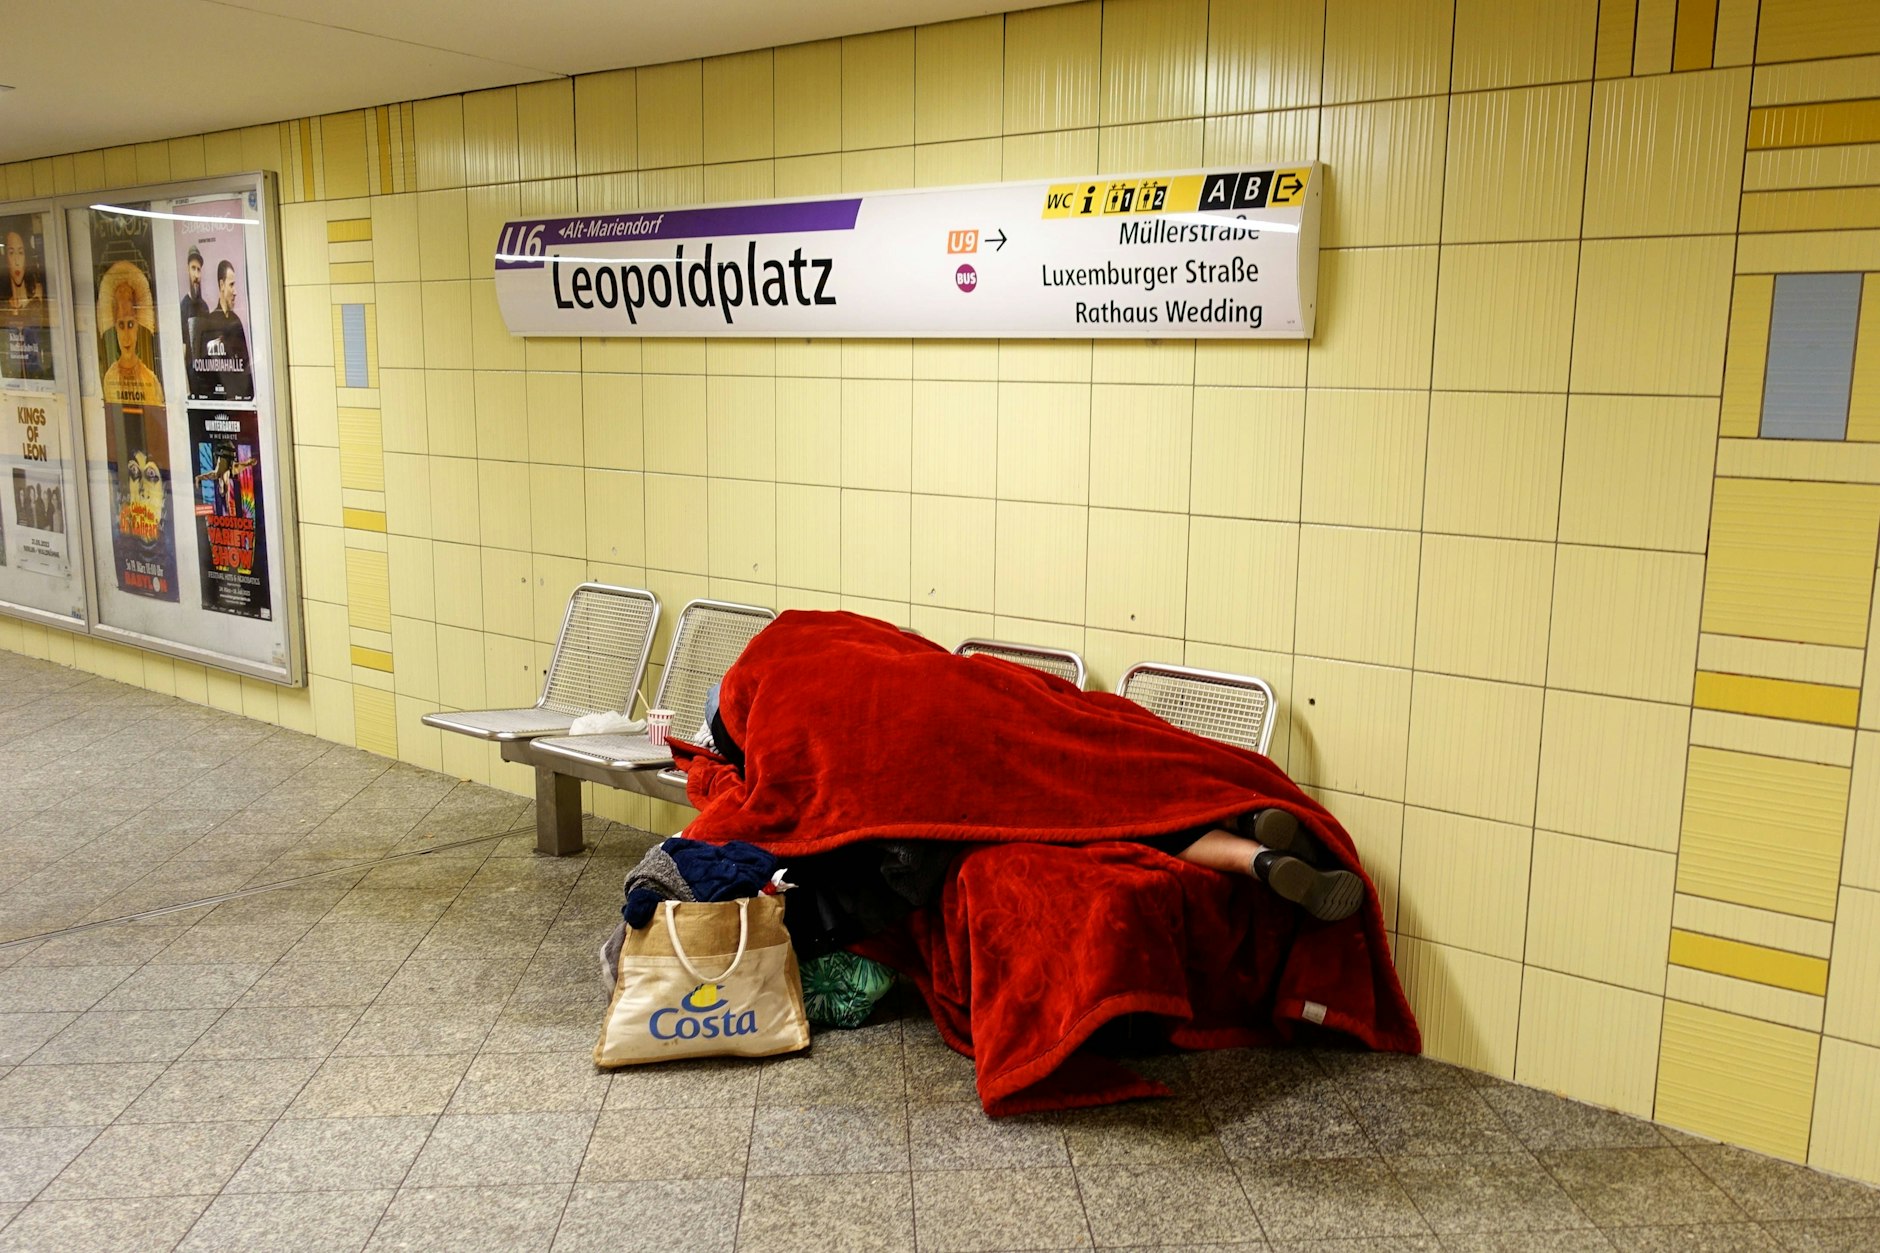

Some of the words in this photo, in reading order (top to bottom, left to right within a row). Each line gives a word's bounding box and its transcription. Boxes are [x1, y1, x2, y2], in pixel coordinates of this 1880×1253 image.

[1047, 192, 1073, 209] WC
[1207, 178, 1225, 203] A
[1243, 176, 1261, 201] B
[502, 224, 545, 263] U6
[564, 214, 663, 239] Alt-Mariendorf
[951, 231, 976, 252] U9
[552, 241, 836, 324] Leopoldplatz
[956, 271, 977, 286] BUS
[1042, 261, 1178, 291] Luxemburger
[1185, 256, 1259, 283] Straße
[1075, 300, 1158, 324] Rathaus
[1166, 298, 1263, 329] Wedding
[194, 358, 244, 372] COLUMBIAHALLE
[117, 390, 145, 401] BABYLON
[17, 406, 47, 426] KINGS
[26, 425, 39, 443] OF
[22, 442, 47, 462] LEON
[206, 515, 254, 530] WOODSTOCK
[207, 527, 254, 550] VARIETY
[212, 545, 253, 569] SHOW
[649, 1008, 758, 1040] Costa
